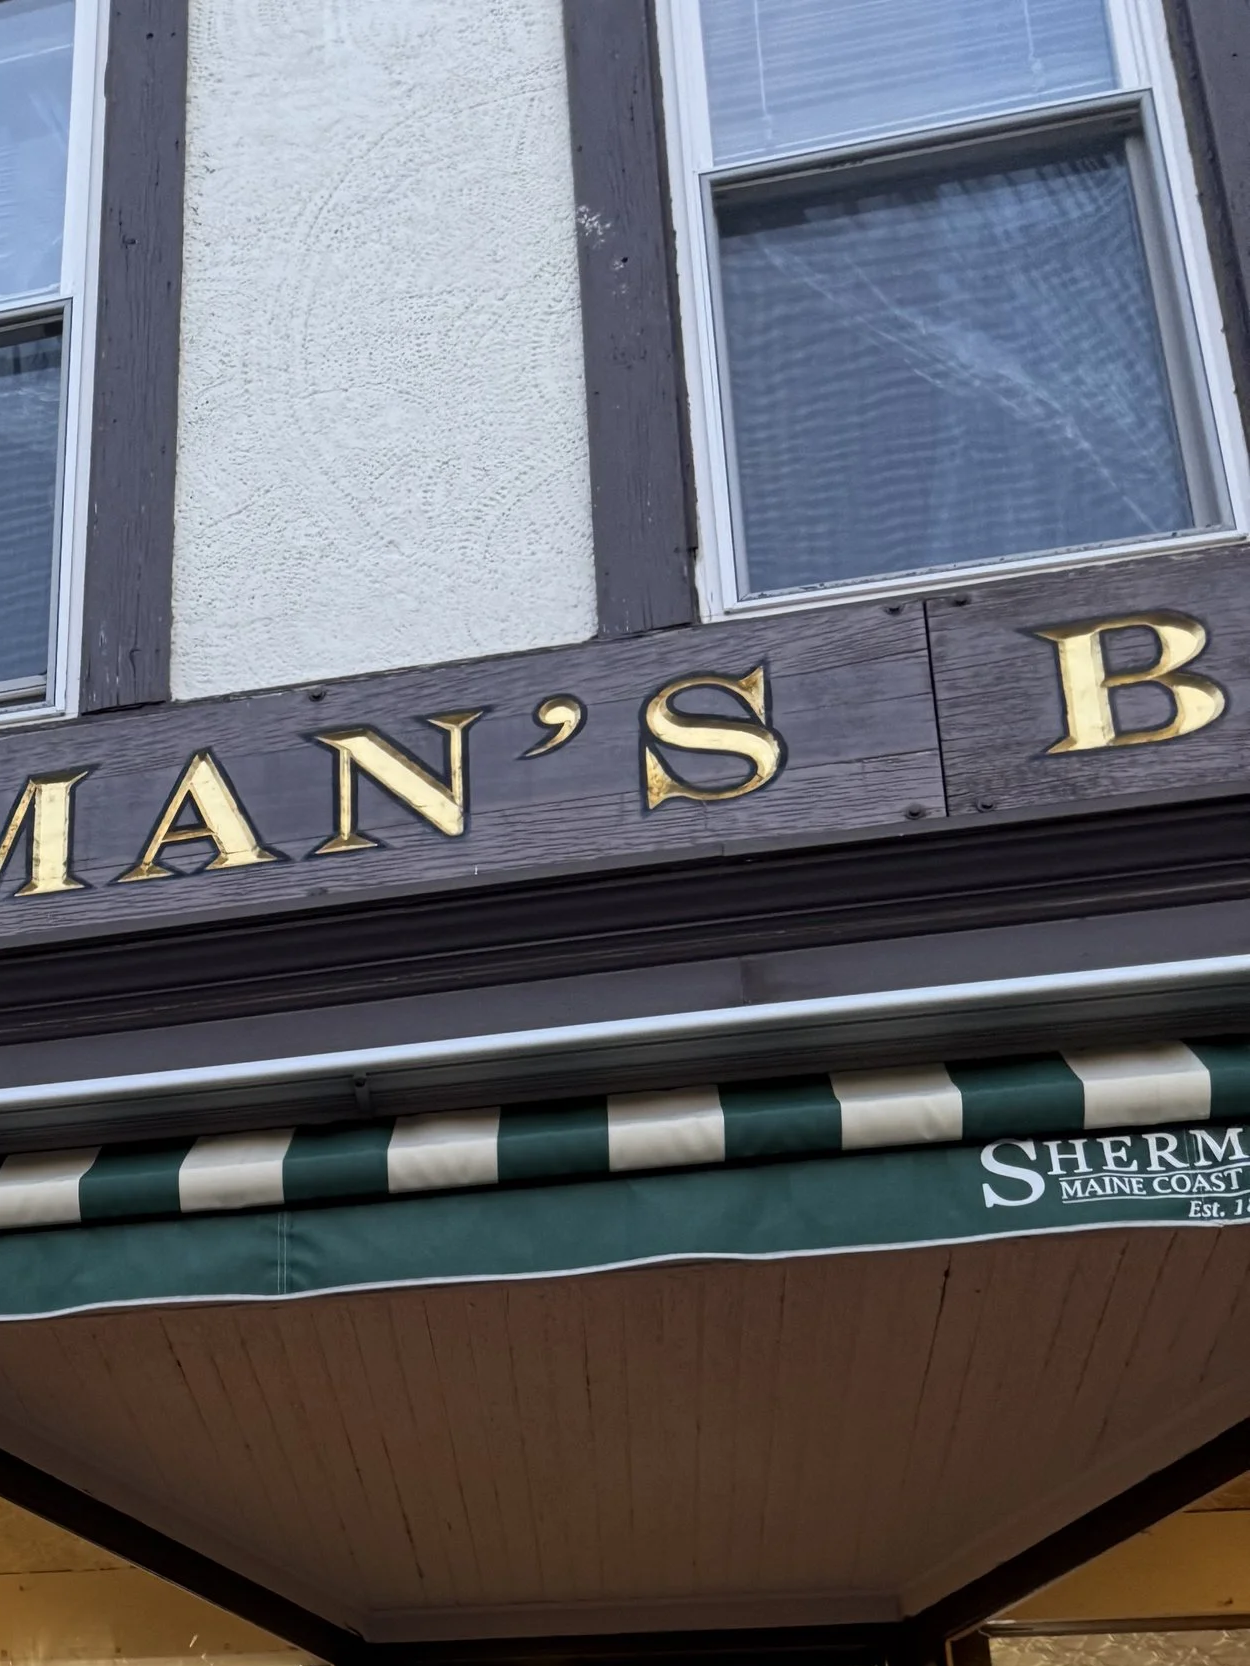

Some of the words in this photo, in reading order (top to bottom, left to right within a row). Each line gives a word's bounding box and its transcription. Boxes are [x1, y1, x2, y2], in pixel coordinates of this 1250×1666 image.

[1060, 1176, 1147, 1200] MAINE
[1153, 1169, 1243, 1195] COAST
[1188, 1200, 1226, 1219] Est.
